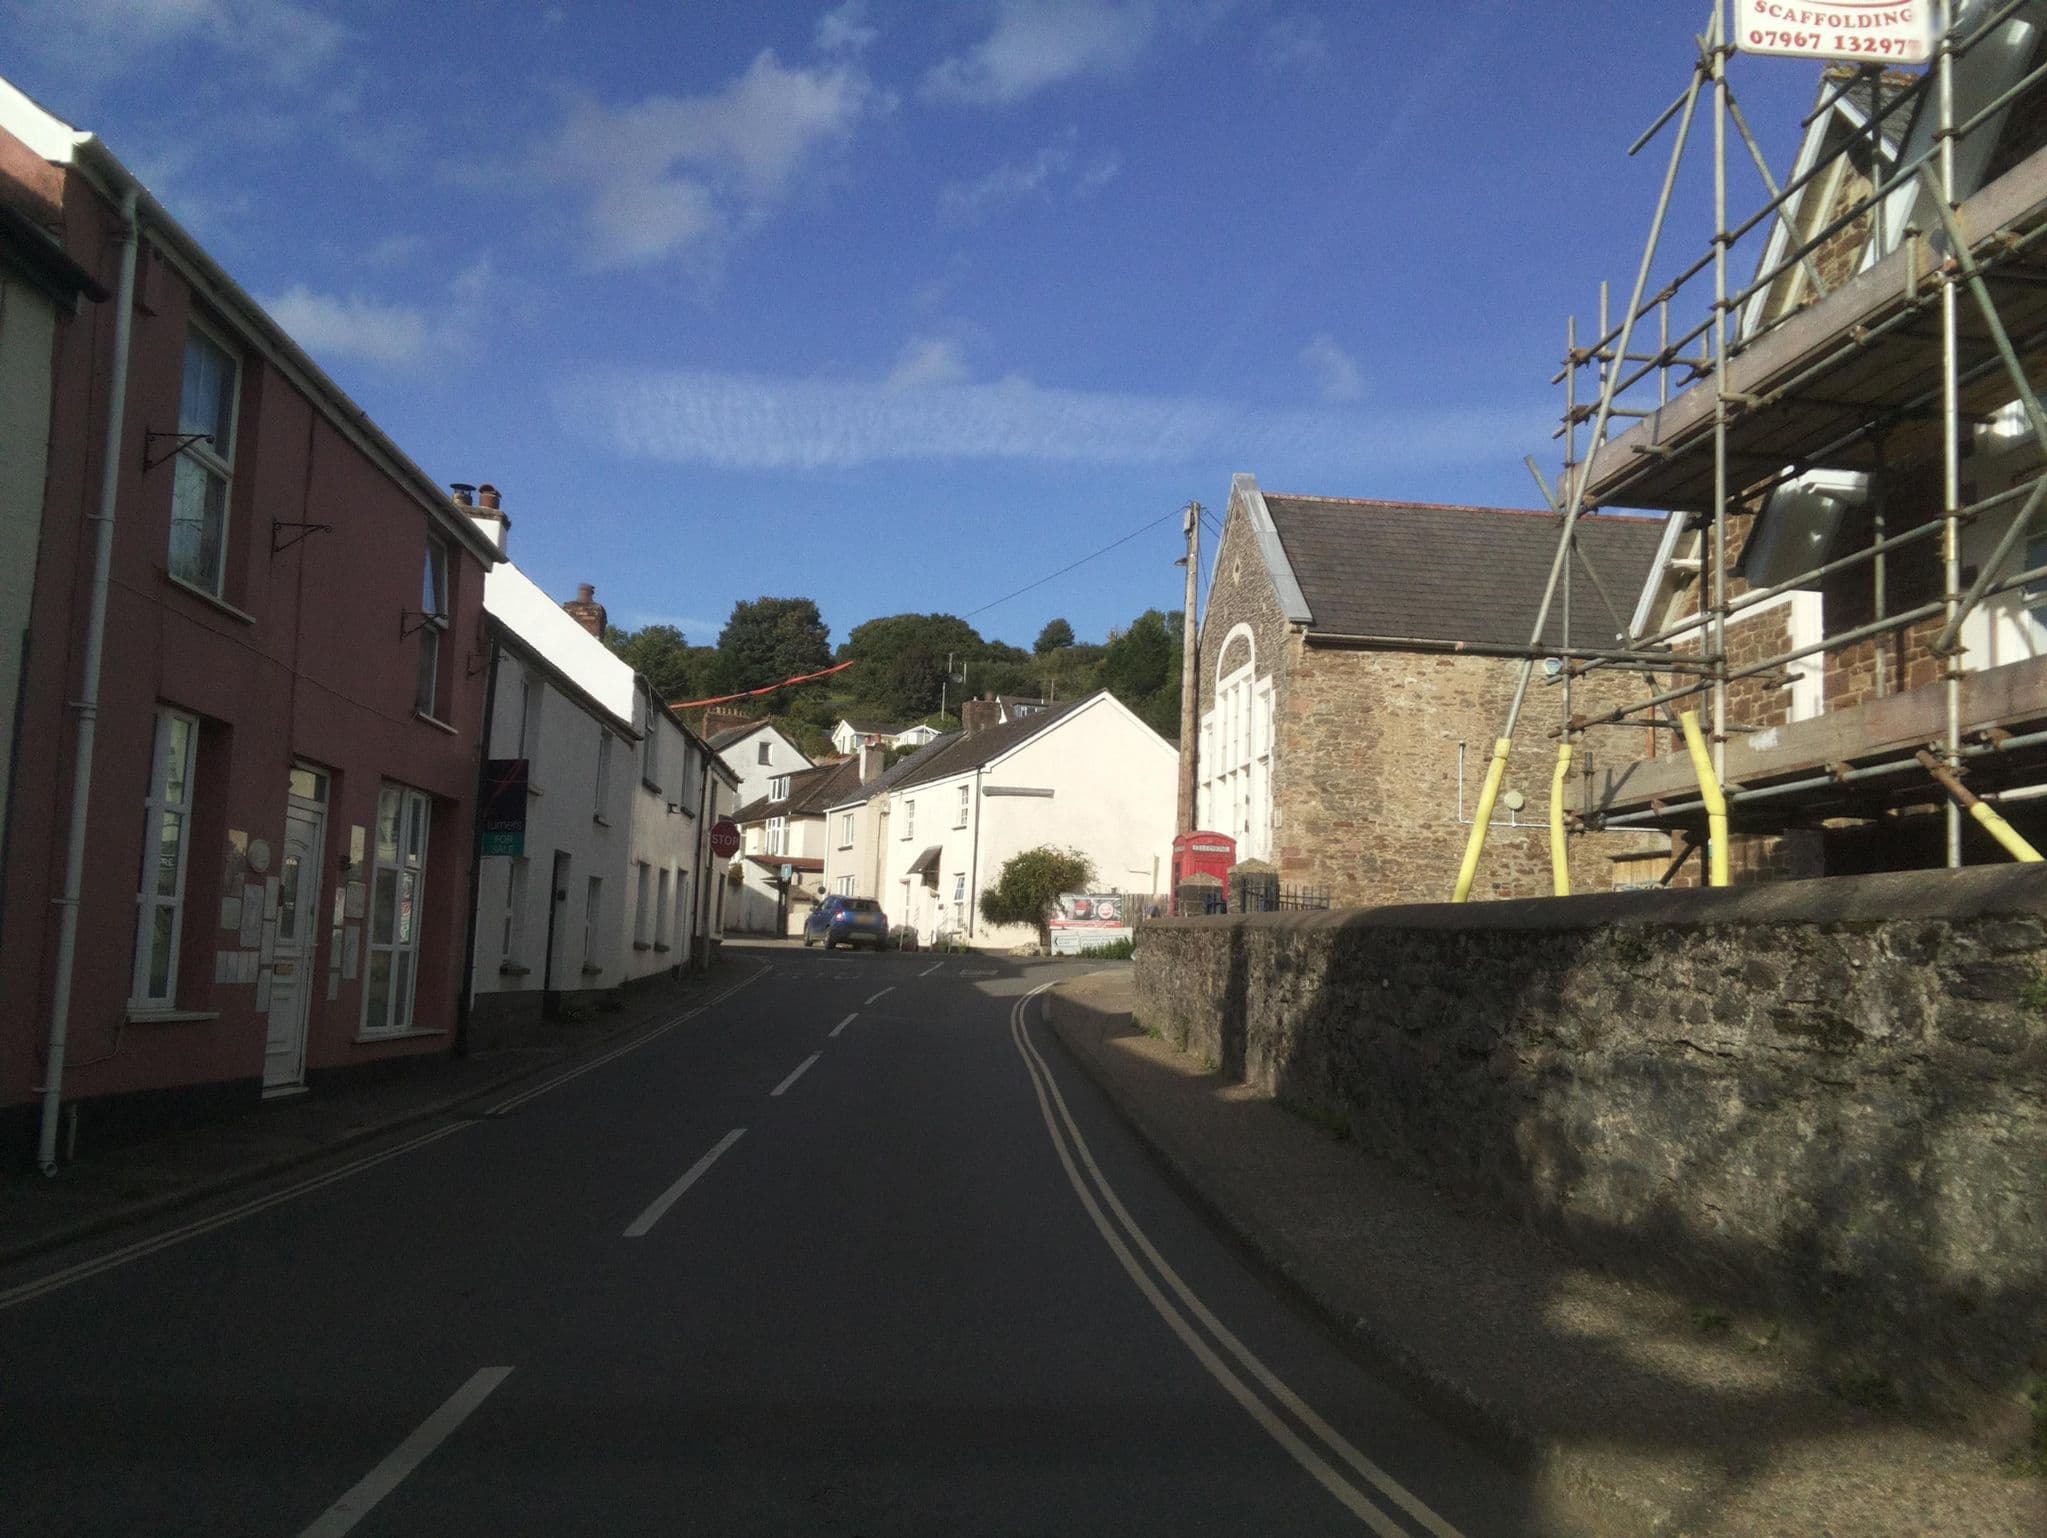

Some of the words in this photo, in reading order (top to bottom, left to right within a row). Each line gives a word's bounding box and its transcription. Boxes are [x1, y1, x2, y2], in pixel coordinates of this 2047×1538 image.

[1753, 0, 1913, 28] SCAFFOLDING
[1749, 30, 1822, 49] 07967
[1834, 35, 1921, 56] 13297
[712, 833, 739, 846] STOP
